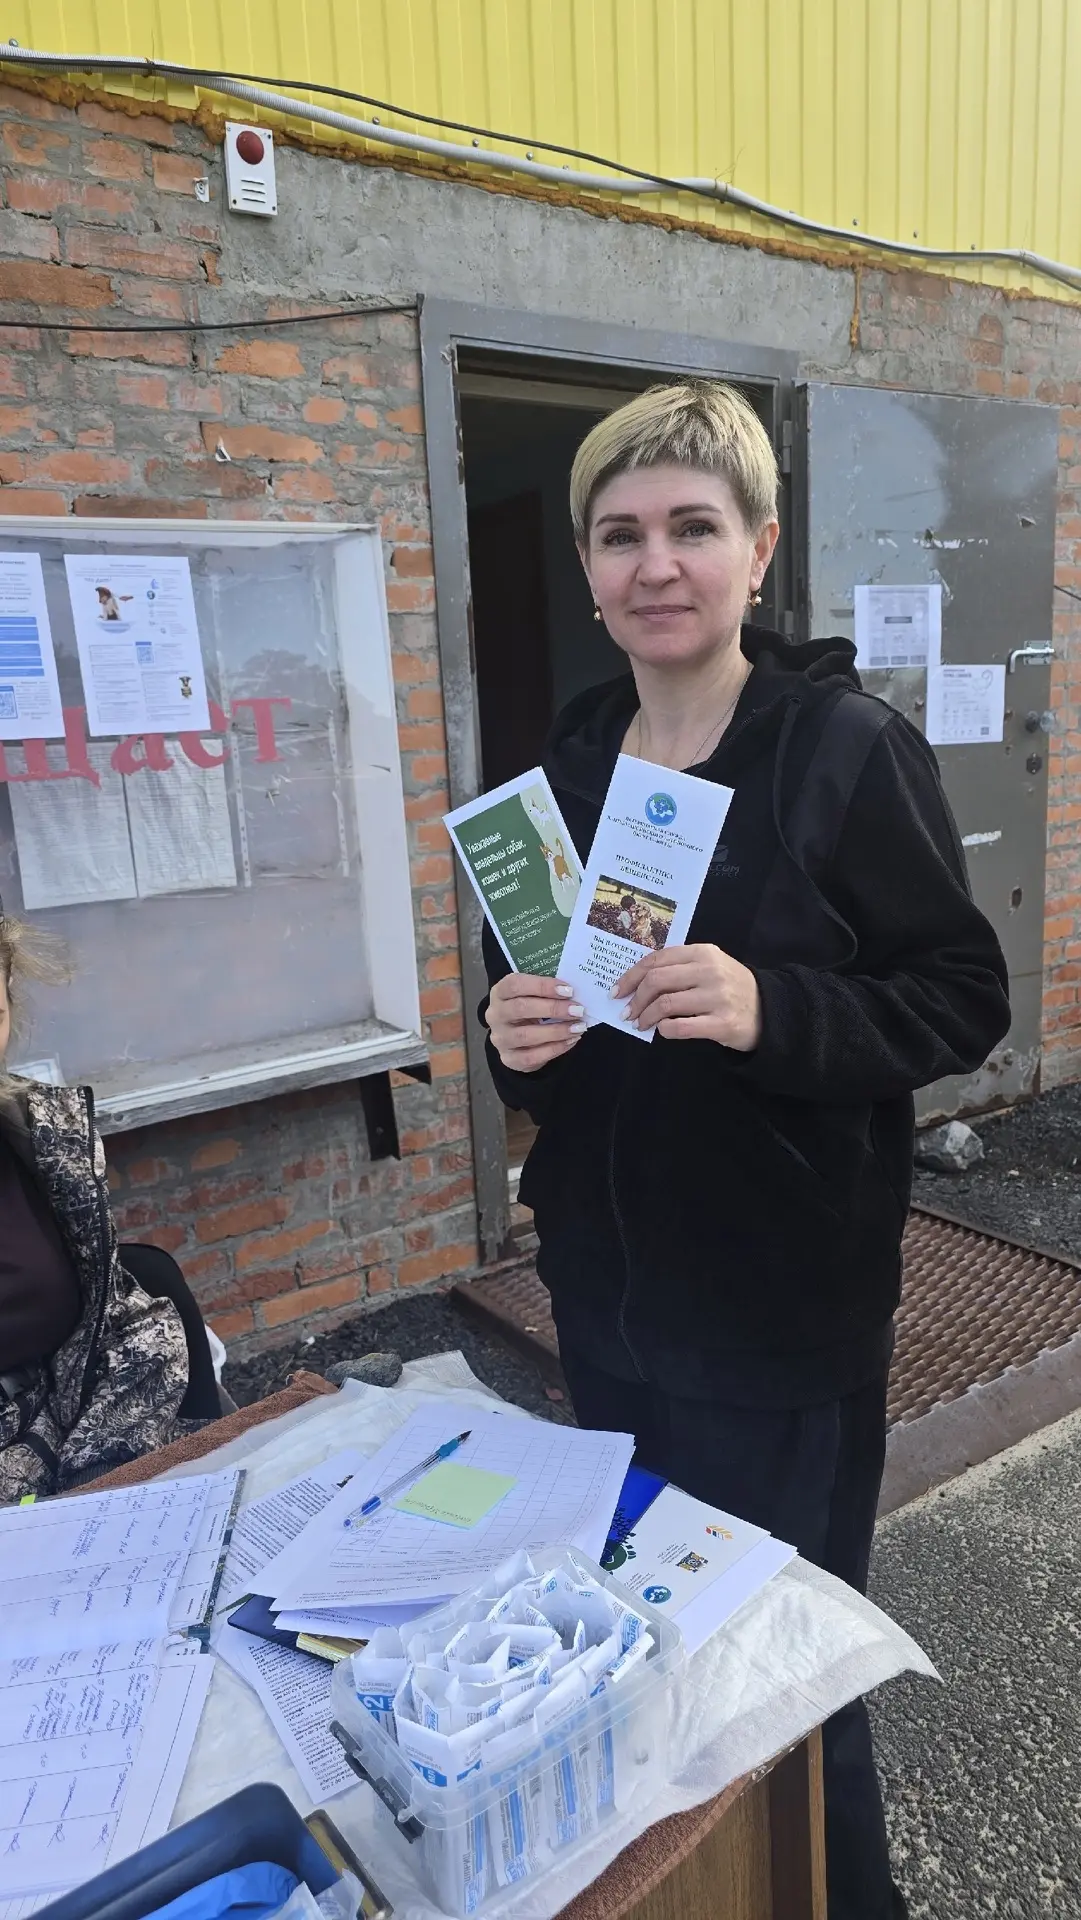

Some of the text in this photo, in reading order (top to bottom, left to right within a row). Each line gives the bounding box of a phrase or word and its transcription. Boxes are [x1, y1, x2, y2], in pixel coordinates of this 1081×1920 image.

[465, 832, 502, 855] Уважаемые
[474, 849, 506, 871] владельцы
[481, 857, 530, 886] кошек и других
[616, 854, 674, 880] ПРОФИЛАКТИКА
[488, 878, 521, 902] животных!
[363, 1696, 384, 1709] 2
